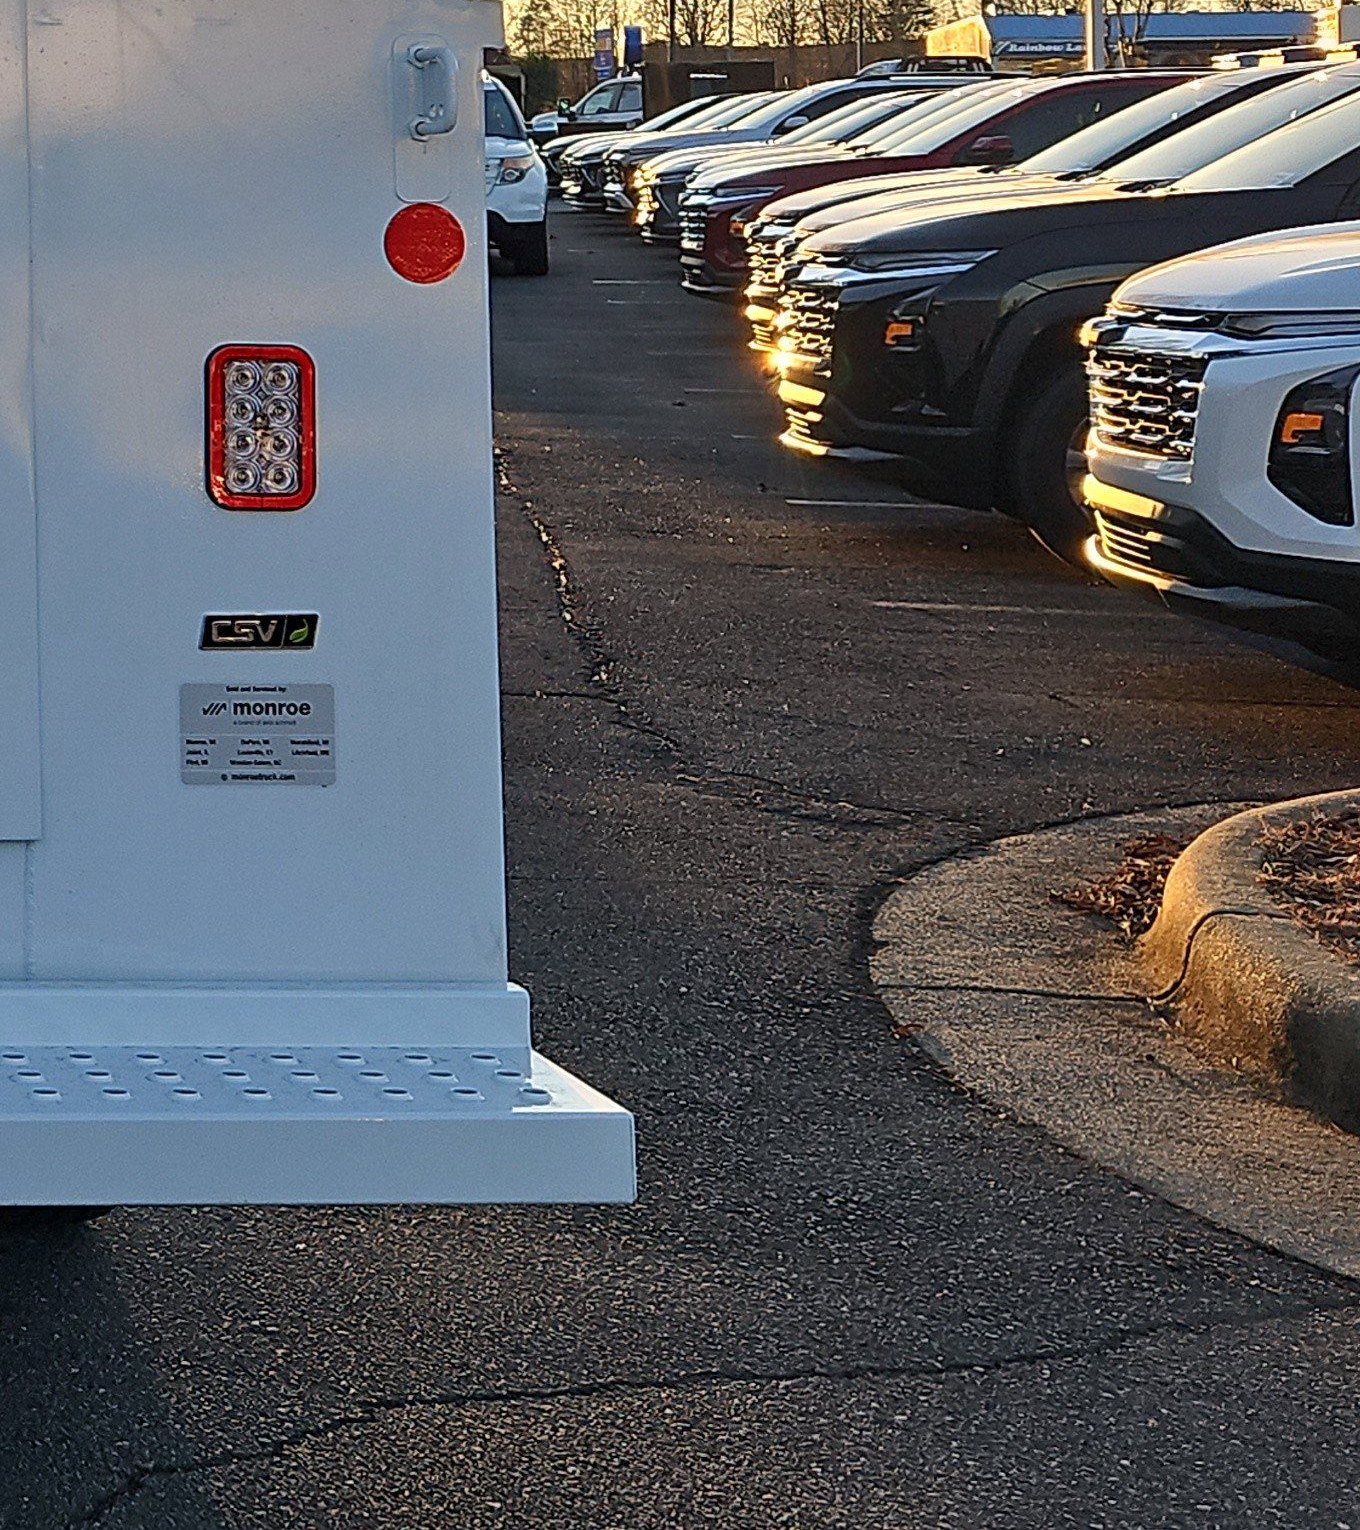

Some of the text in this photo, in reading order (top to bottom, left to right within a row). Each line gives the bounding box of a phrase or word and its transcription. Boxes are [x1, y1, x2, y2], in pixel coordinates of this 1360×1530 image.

[1008, 43, 1063, 52] Rainbow
[212, 620, 278, 642] CSV
[233, 702, 311, 716] monroe
